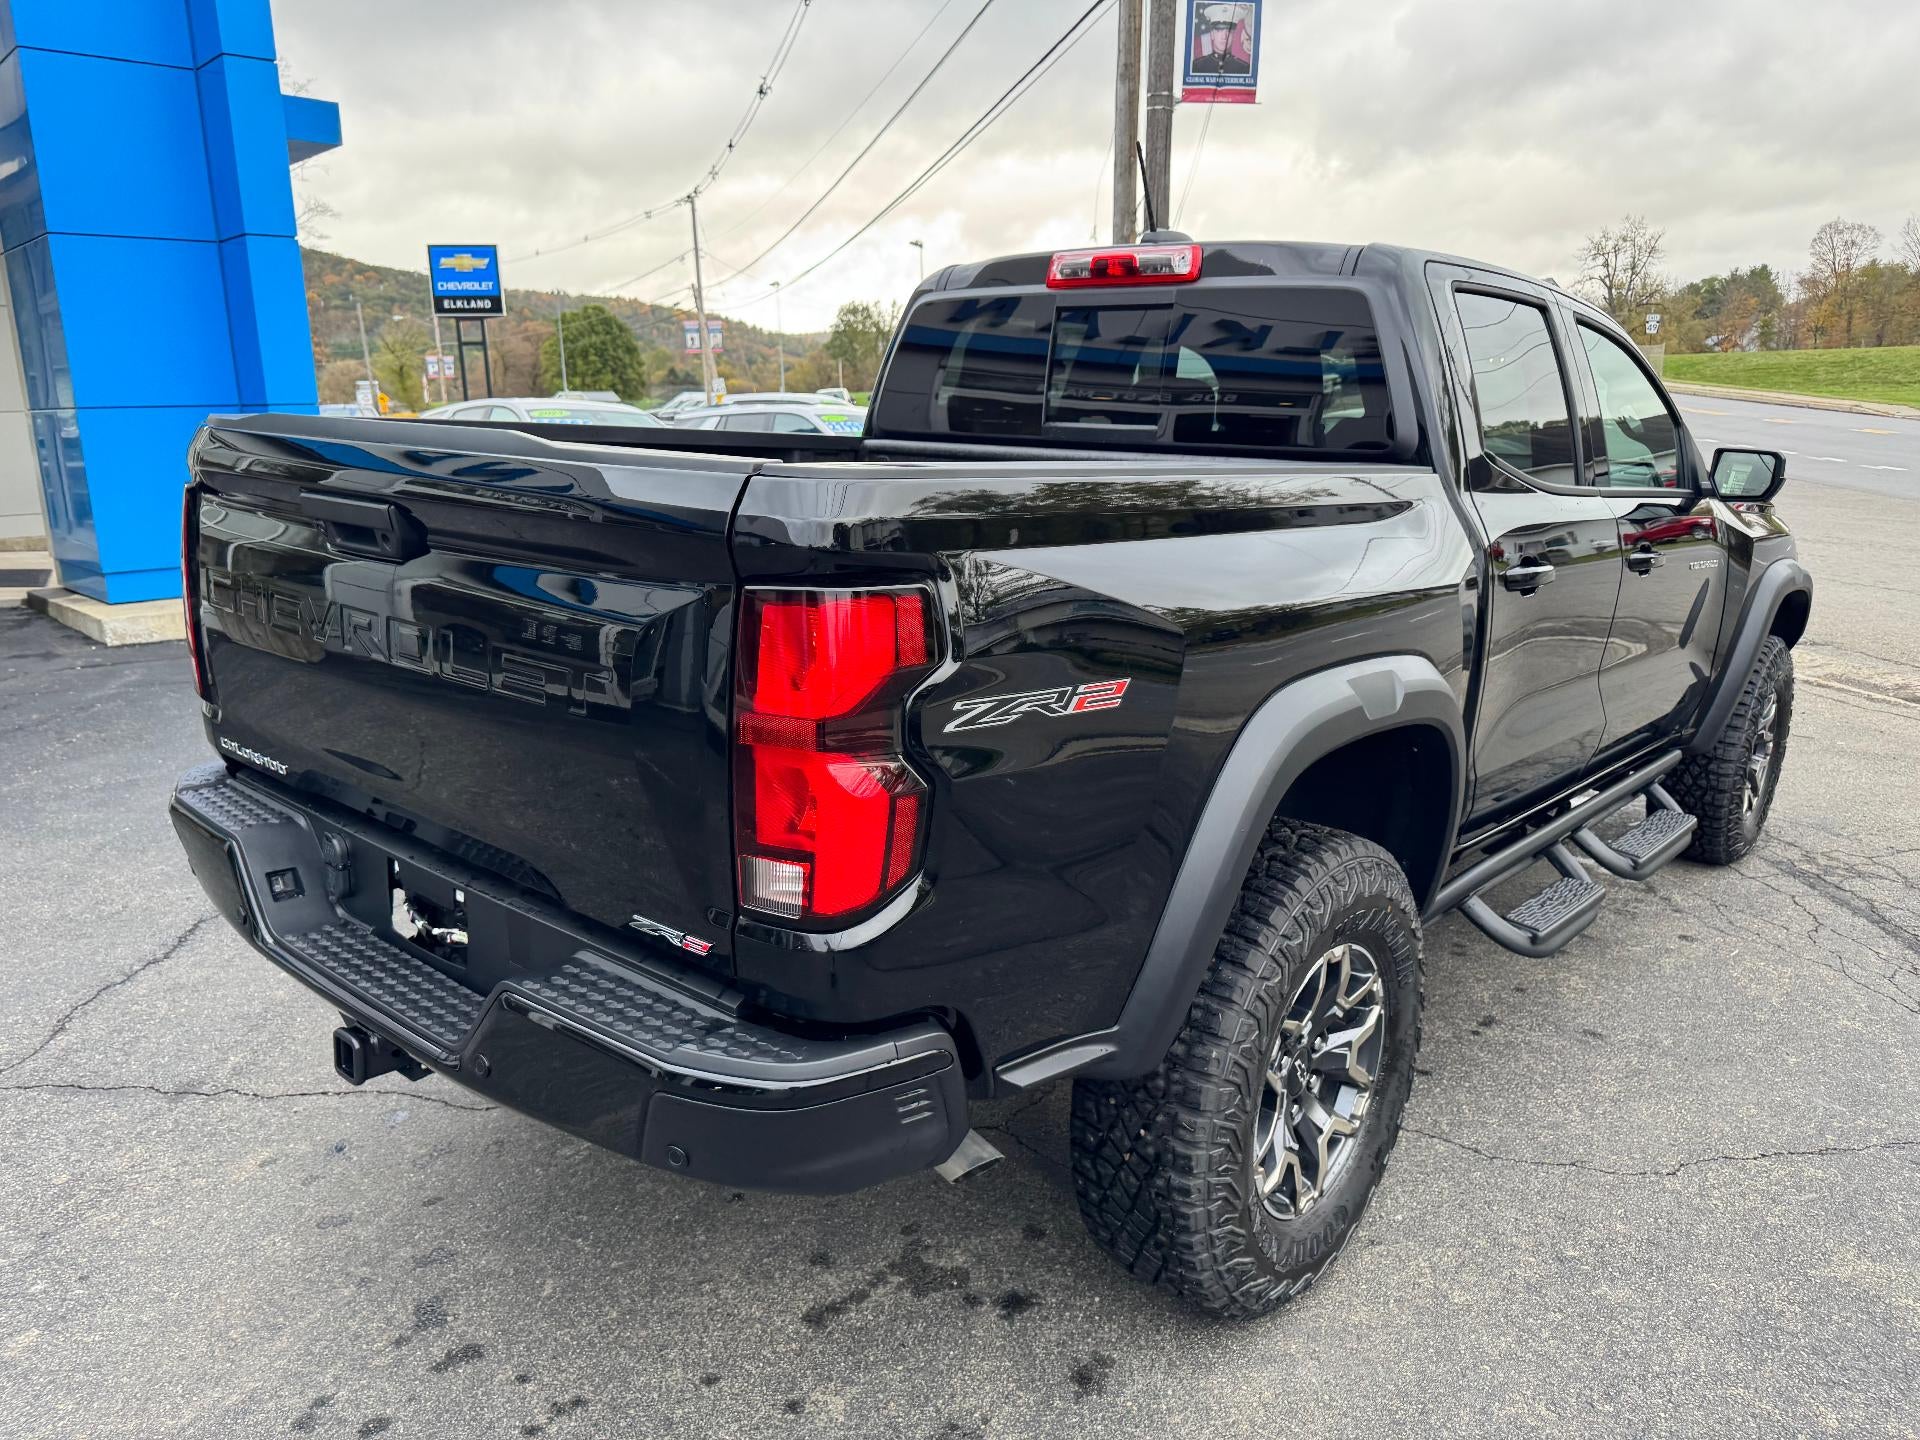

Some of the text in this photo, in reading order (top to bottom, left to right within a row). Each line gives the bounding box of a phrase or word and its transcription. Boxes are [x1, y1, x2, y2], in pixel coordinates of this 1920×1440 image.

[437, 281, 494, 291] CHEVROLET
[443, 298, 492, 309] ELKLAND
[1647, 324, 1658, 332] 49
[206, 565, 613, 717] CHEVROLET
[942, 677, 1132, 732] ZR2
[628, 914, 715, 957] ZR2
